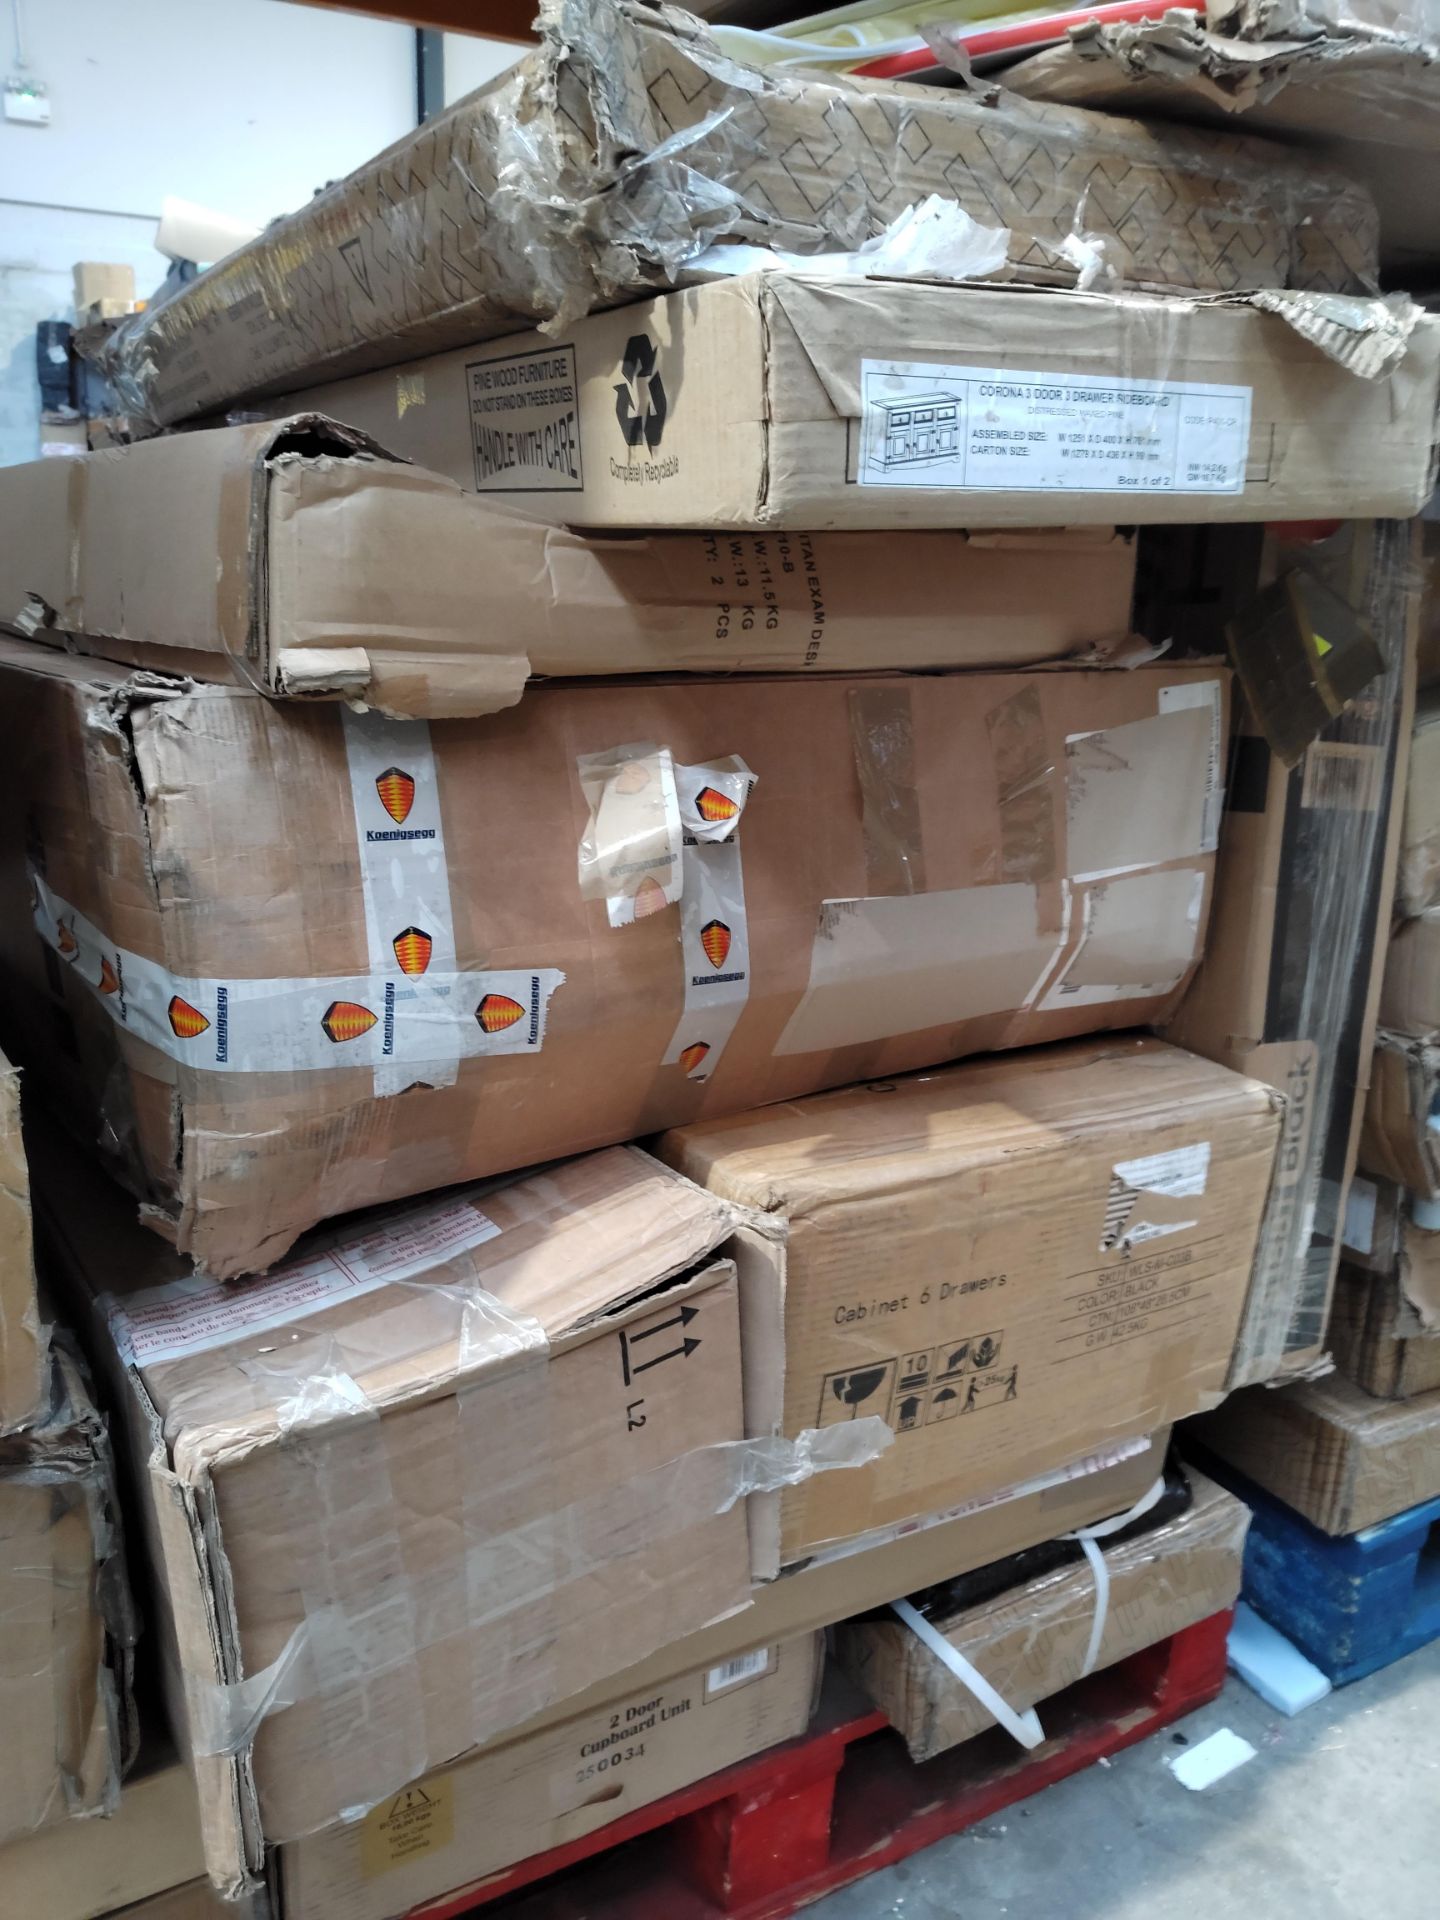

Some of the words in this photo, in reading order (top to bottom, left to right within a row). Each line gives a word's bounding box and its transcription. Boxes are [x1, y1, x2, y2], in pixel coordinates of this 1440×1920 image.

[474, 371, 492, 391] PINE
[492, 367, 517, 388] WOOD
[518, 358, 568, 384] FURNITURE
[473, 399, 483, 413] DO
[482, 397, 494, 412] NOT
[495, 394, 516, 412] STAND
[516, 393, 527, 409] ON
[527, 390, 549, 408] THESE
[550, 385, 574, 405] BOXES
[979, 385, 1023, 398] CORONA
[1025, 388, 1032, 399] 3
[1034, 388, 1063, 401] DOOR
[1066, 390, 1072, 401] 3
[1073, 391, 1115, 404] DRAWER
[1117, 393, 1170, 407] SIDEBOAD
[1027, 406, 1077, 417] DISTRESSED
[474, 421, 515, 482] HANDLE
[514, 429, 544, 467] WITH
[544, 411, 578, 480] CARE
[970, 445, 1008, 456] CARTON
[1010, 446, 1030, 457] SIZE:
[1062, 448, 1069, 458] W
[972, 429, 1026, 441] ASSEMBLED
[1058, 433, 1066, 442] W
[610, 456, 644, 486] Completely
[644, 454, 679, 484] Recyclable
[1117, 475, 1138, 485] Box
[1142, 476, 1148, 485] 1
[1151, 476, 1162, 486] of
[1163, 477, 1171, 486] 2
[799, 530, 816, 572] ITAN
[710, 576, 725, 585] 2
[807, 576, 826, 625] EXAM
[715, 603, 731, 639] PCS
[741, 605, 755, 630] KG
[366, 829, 436, 842] Koenigsegg
[692, 971, 745, 987] Koenigsegg
[216, 986, 228, 1063] Koenigsegg
[382, 982, 395, 1055] Koenigsegg
[528, 976, 540, 1045] Koenigsegg
[834, 1294, 909, 1325] Cabinet
[919, 1286, 931, 1304] 6
[939, 1273, 1008, 1301] Drawers
[1125, 1278, 1160, 1298] BLACK
[134, 1331, 155, 1342] ette
[155, 1324, 188, 1338] bande
[907, 1354, 929, 1373] 10
[627, 1399, 647, 1432] L2
[580, 1714, 655, 1758] Cupboard
[661, 1699, 691, 1722] Unit
[609, 1714, 620, 1729] 2
[626, 1696, 664, 1722] Door
[576, 1744, 645, 1783] 250034
